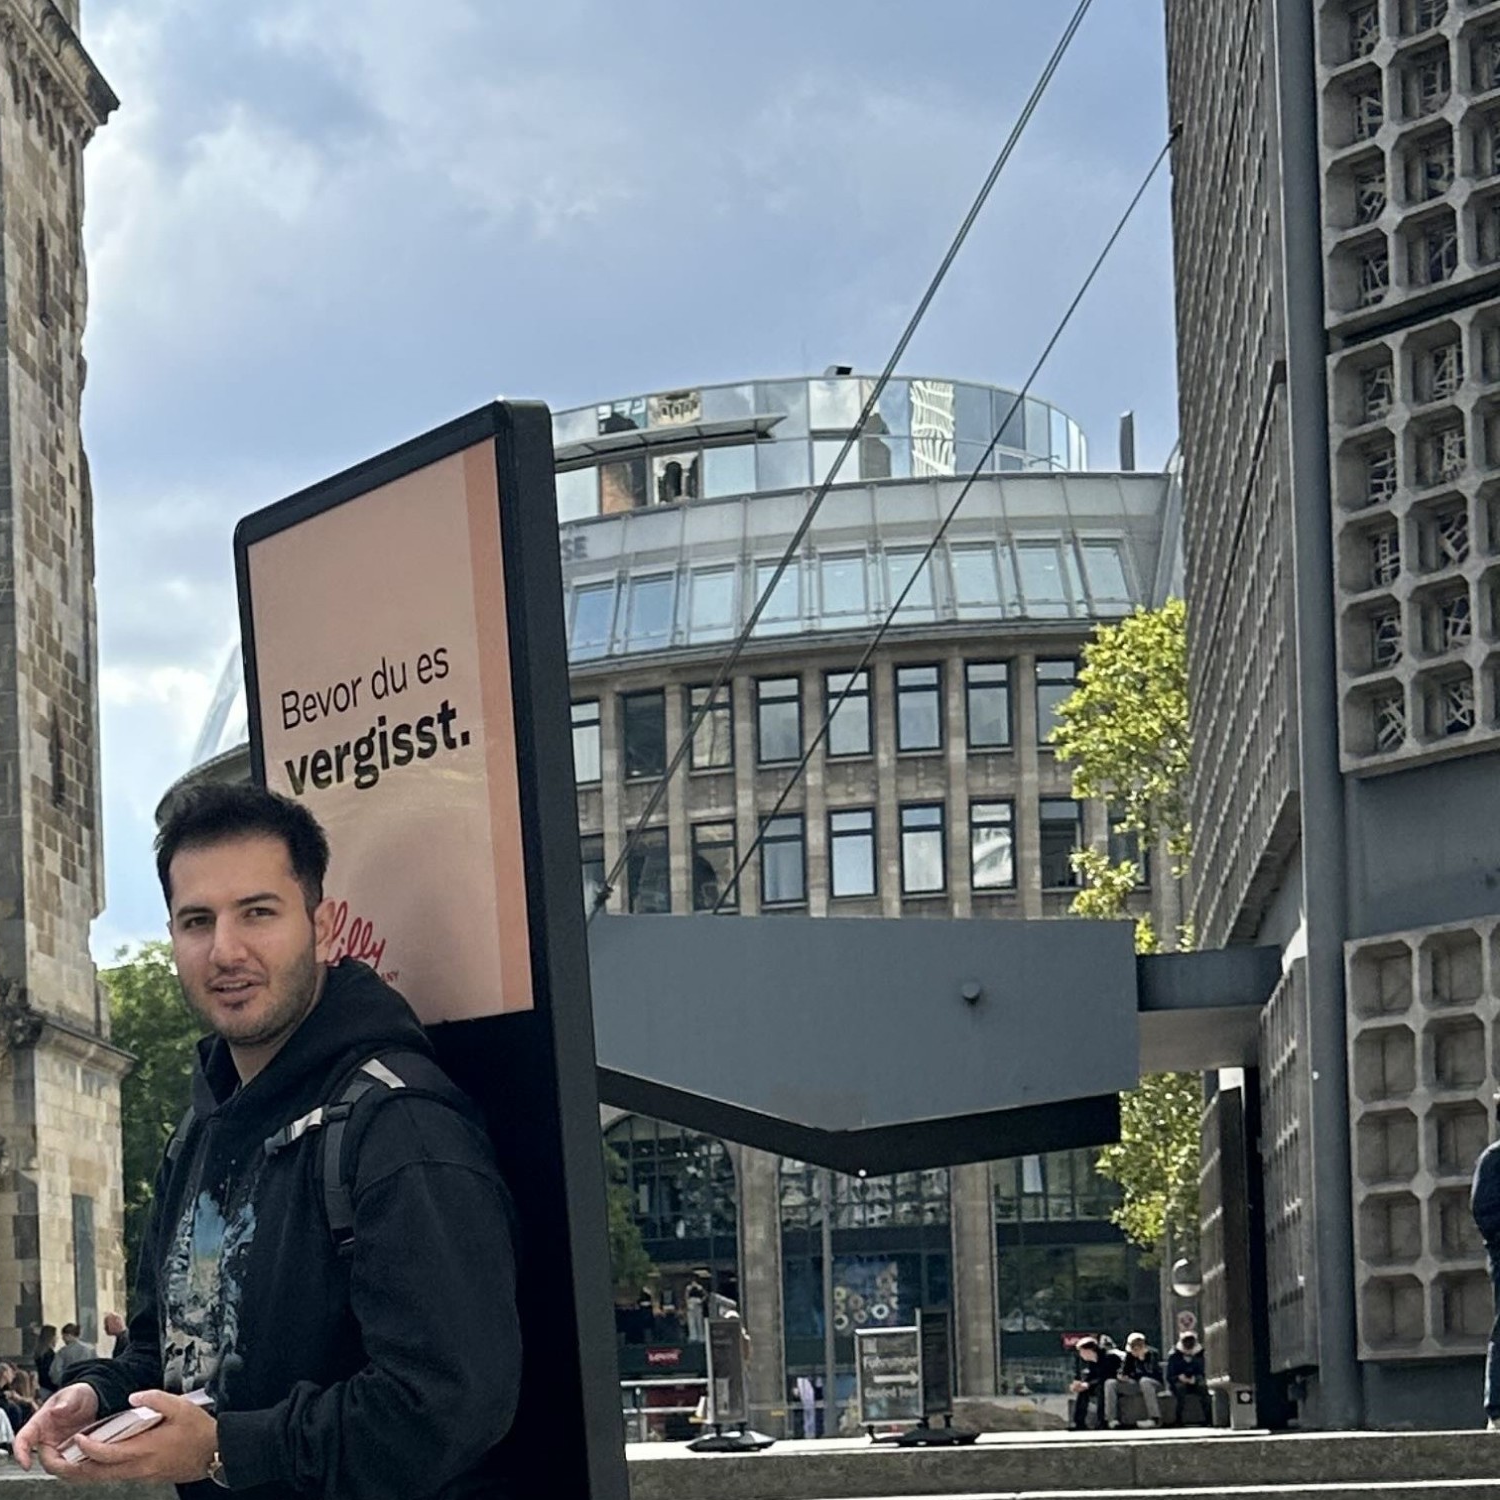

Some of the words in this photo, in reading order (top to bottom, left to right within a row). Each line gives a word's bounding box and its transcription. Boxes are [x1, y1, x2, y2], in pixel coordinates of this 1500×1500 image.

[281, 676, 362, 729] Bevor
[371, 657, 408, 700] du
[416, 647, 450, 685] es
[285, 699, 470, 796] vergisst.
